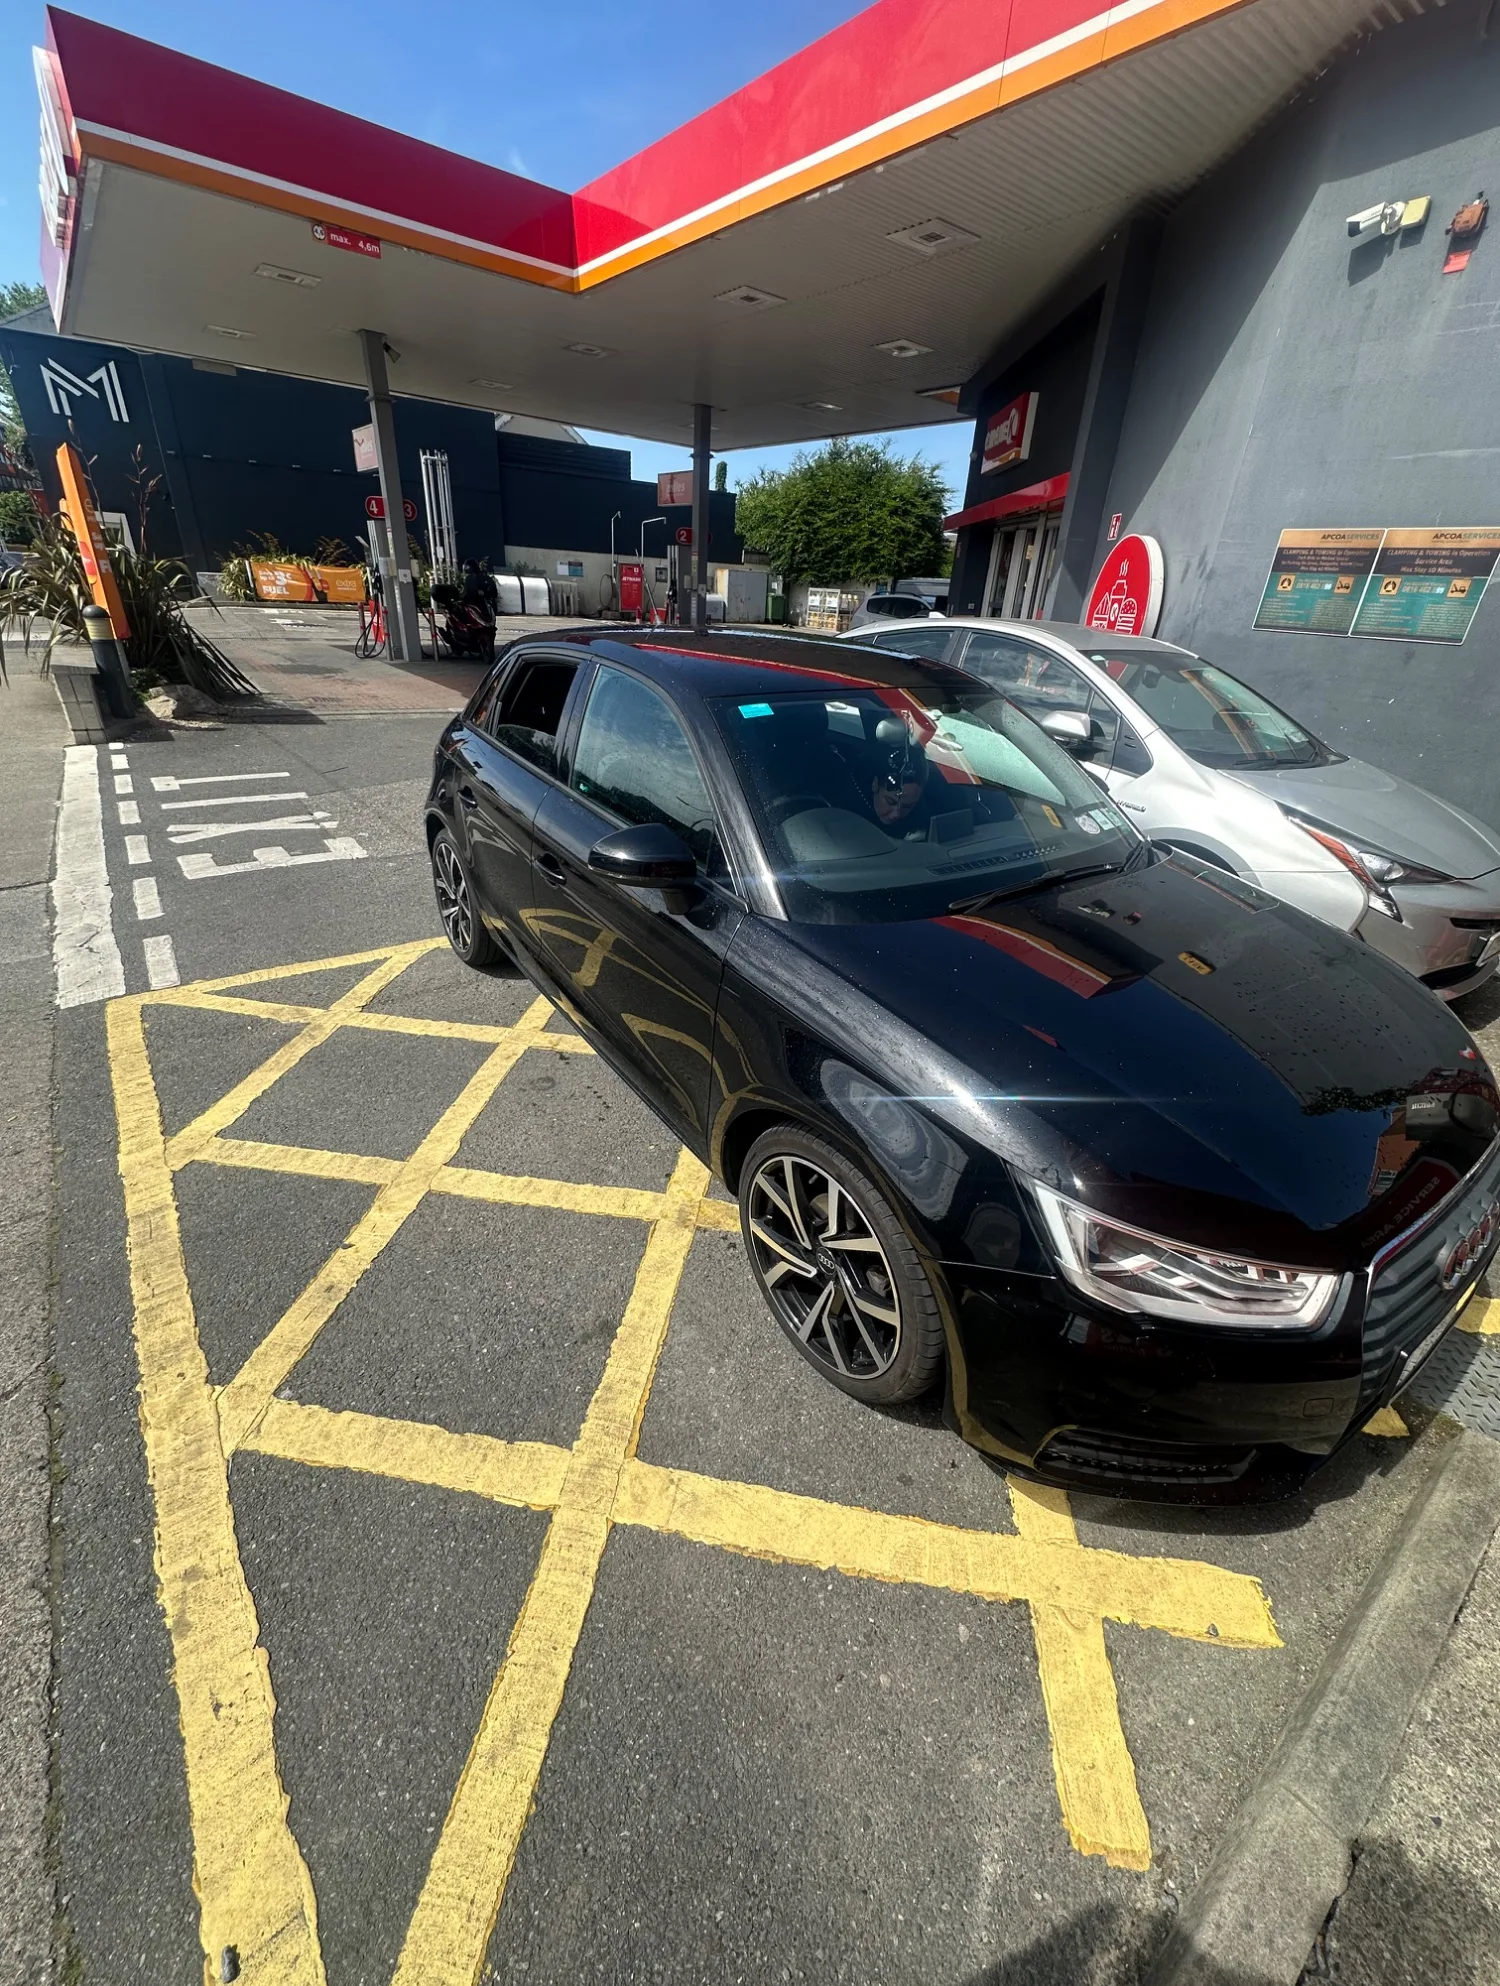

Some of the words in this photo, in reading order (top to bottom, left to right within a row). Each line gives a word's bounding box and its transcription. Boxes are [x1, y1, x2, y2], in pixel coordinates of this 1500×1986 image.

[330, 233, 352, 245] max.
[358, 240, 380, 253] 4,6m
[369, 500, 378, 514] 4
[403, 504, 413, 518] 3
[680, 530, 687, 541] 2
[263, 586, 289, 594] FUEL
